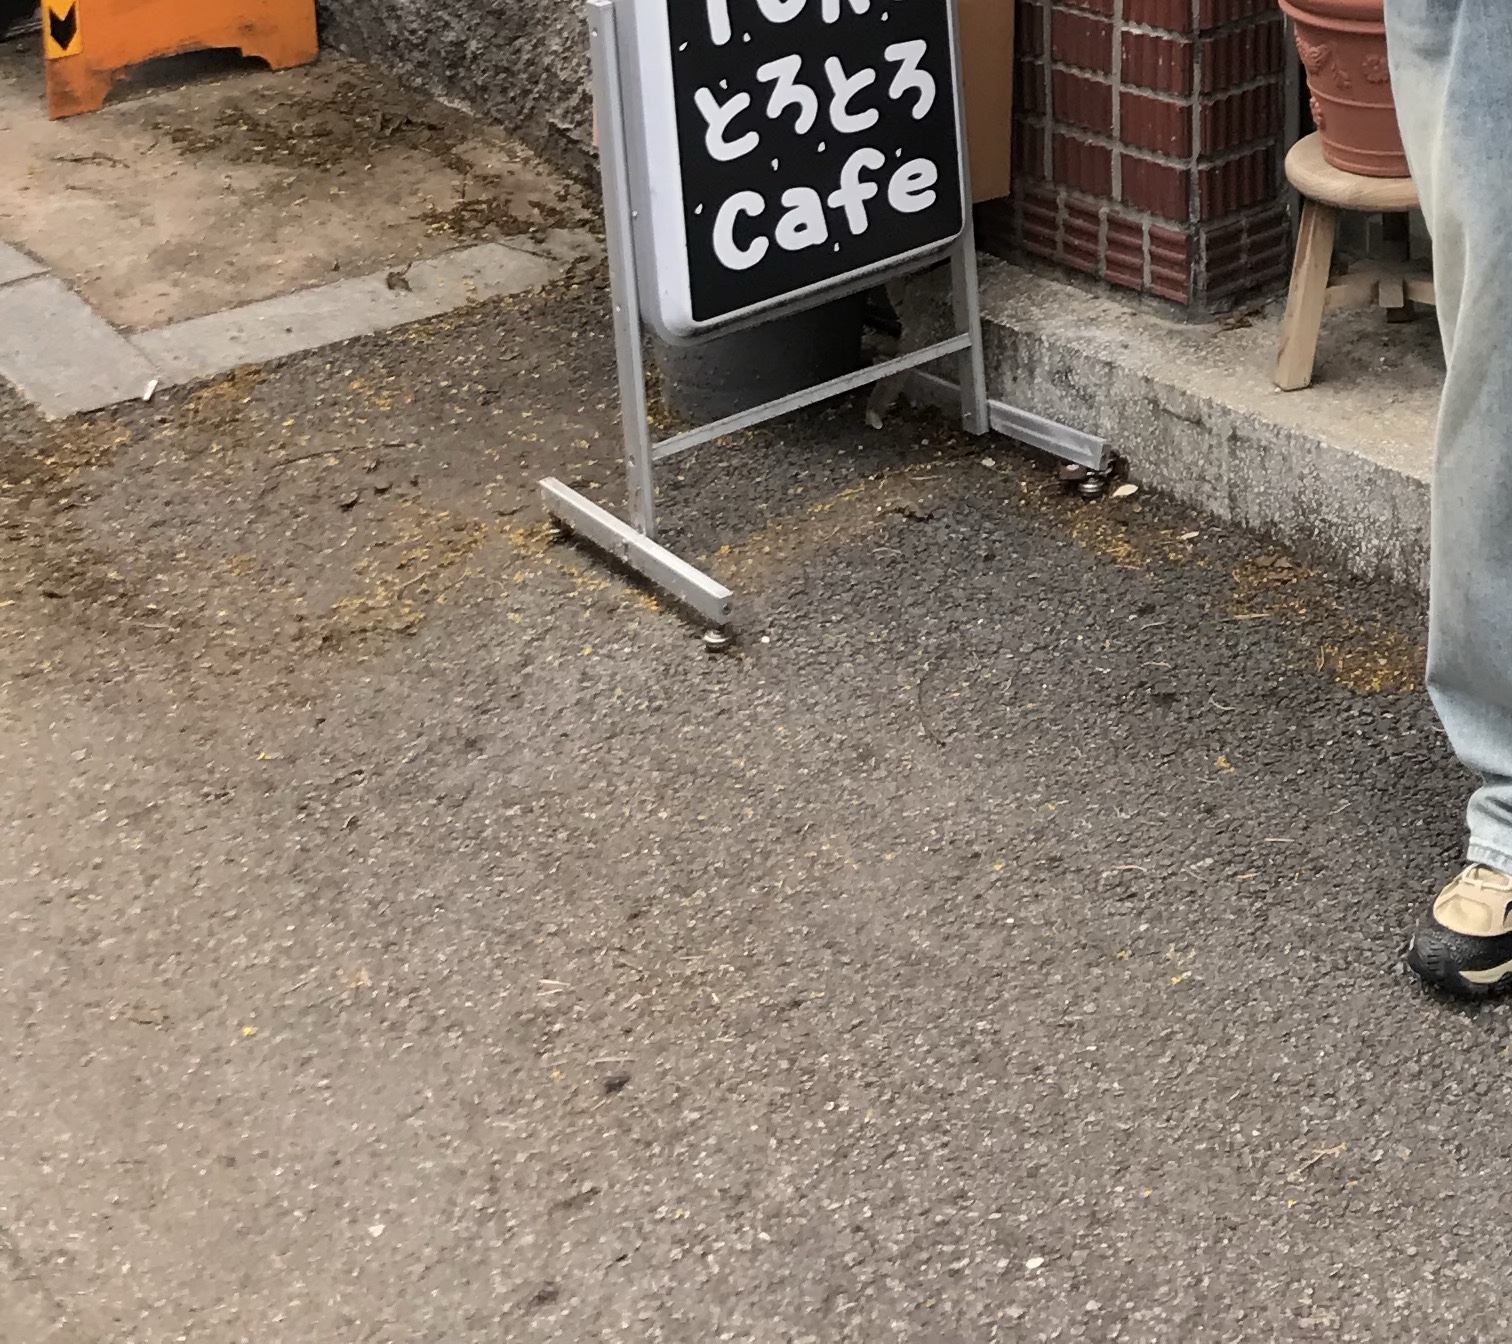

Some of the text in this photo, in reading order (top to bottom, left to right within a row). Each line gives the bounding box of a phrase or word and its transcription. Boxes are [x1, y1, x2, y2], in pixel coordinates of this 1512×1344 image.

[694, 39, 936, 162] とろとろ
[713, 147, 939, 271] Cafe
